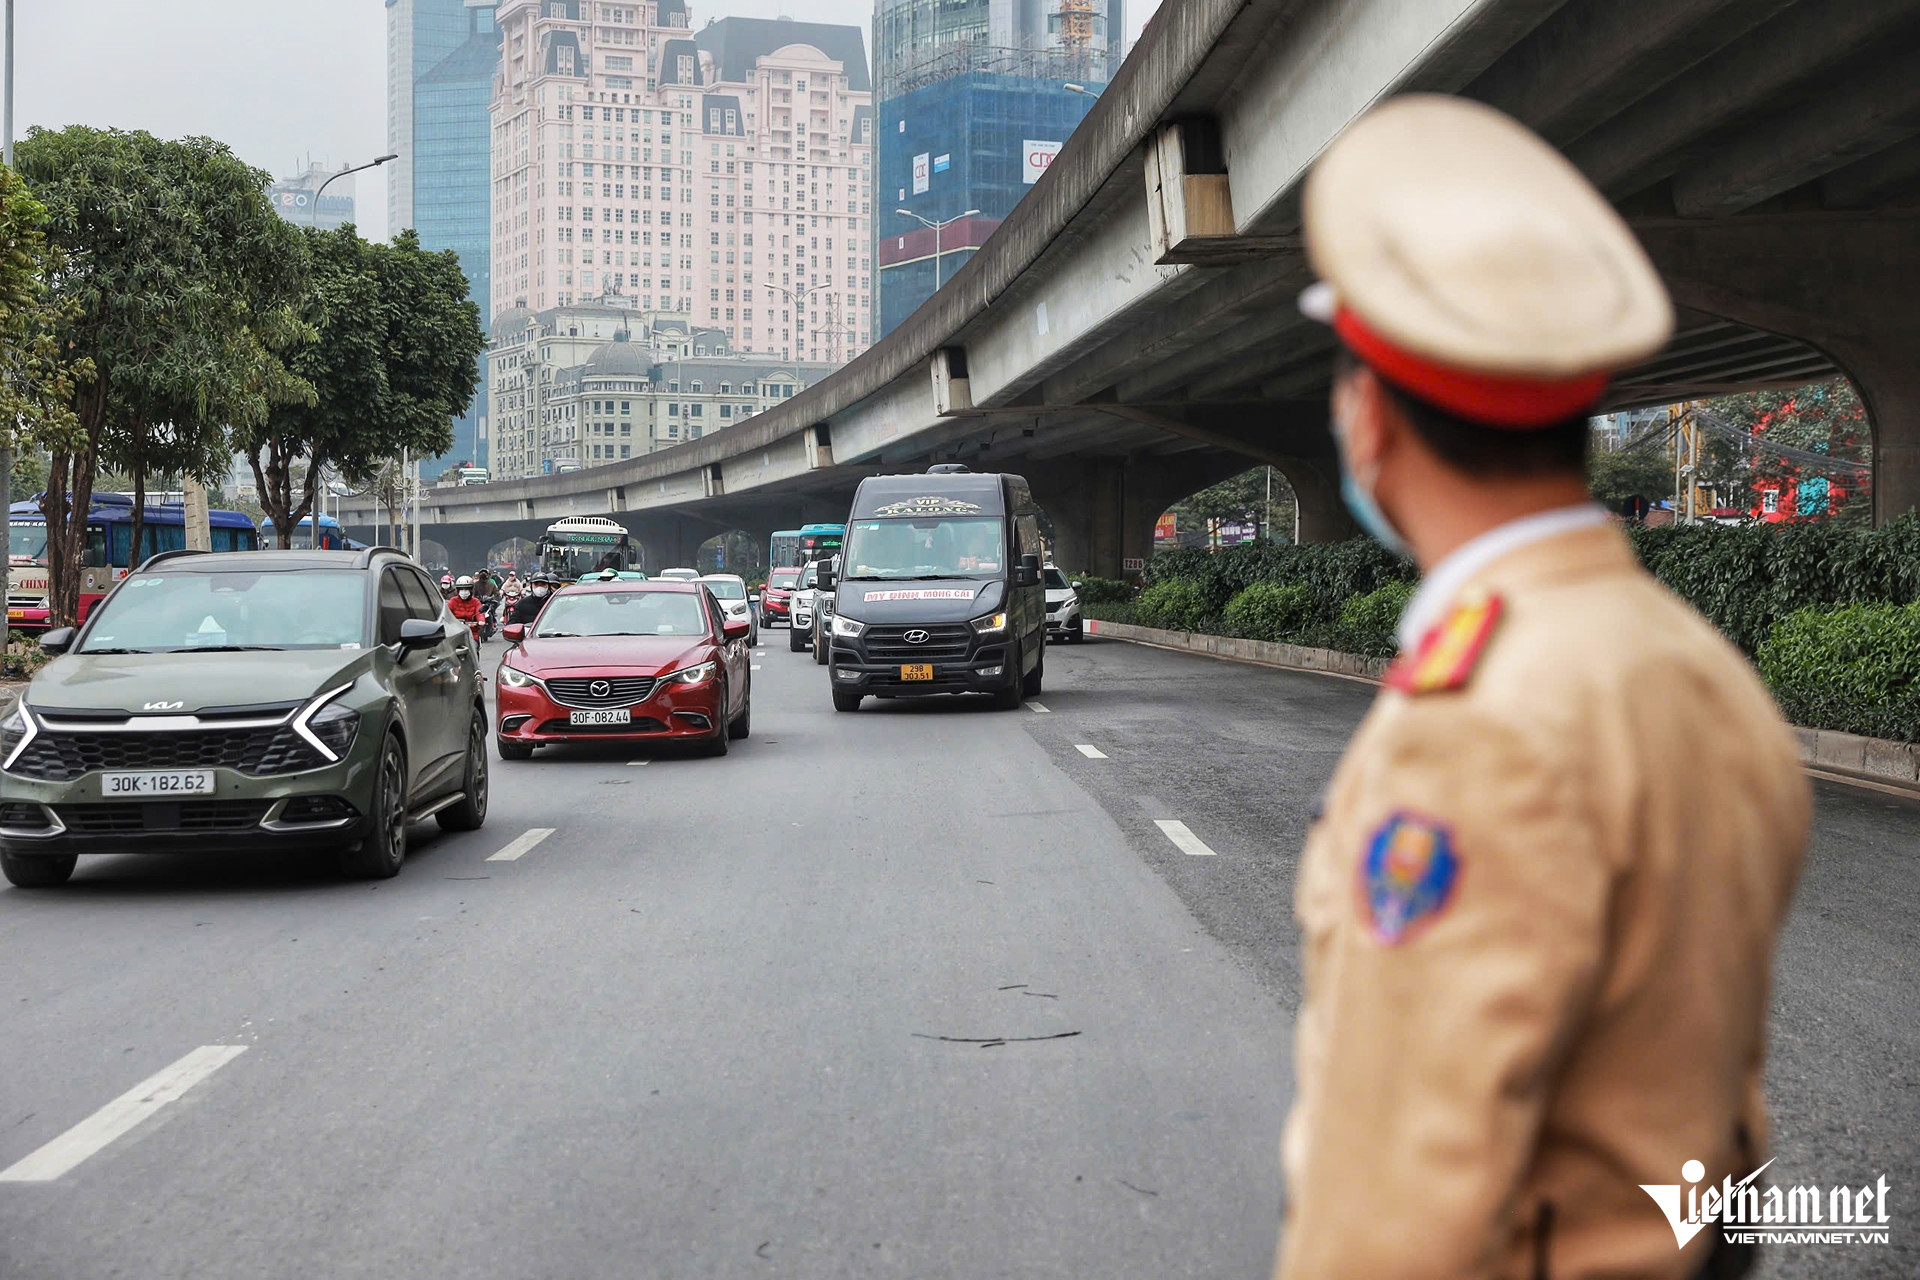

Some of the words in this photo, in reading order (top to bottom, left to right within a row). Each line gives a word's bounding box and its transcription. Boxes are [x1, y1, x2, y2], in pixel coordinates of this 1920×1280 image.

[886, 506, 968, 514] KALONG
[1125, 559, 1143, 568] T286
[111, 775, 205, 792] 30K-182.62
